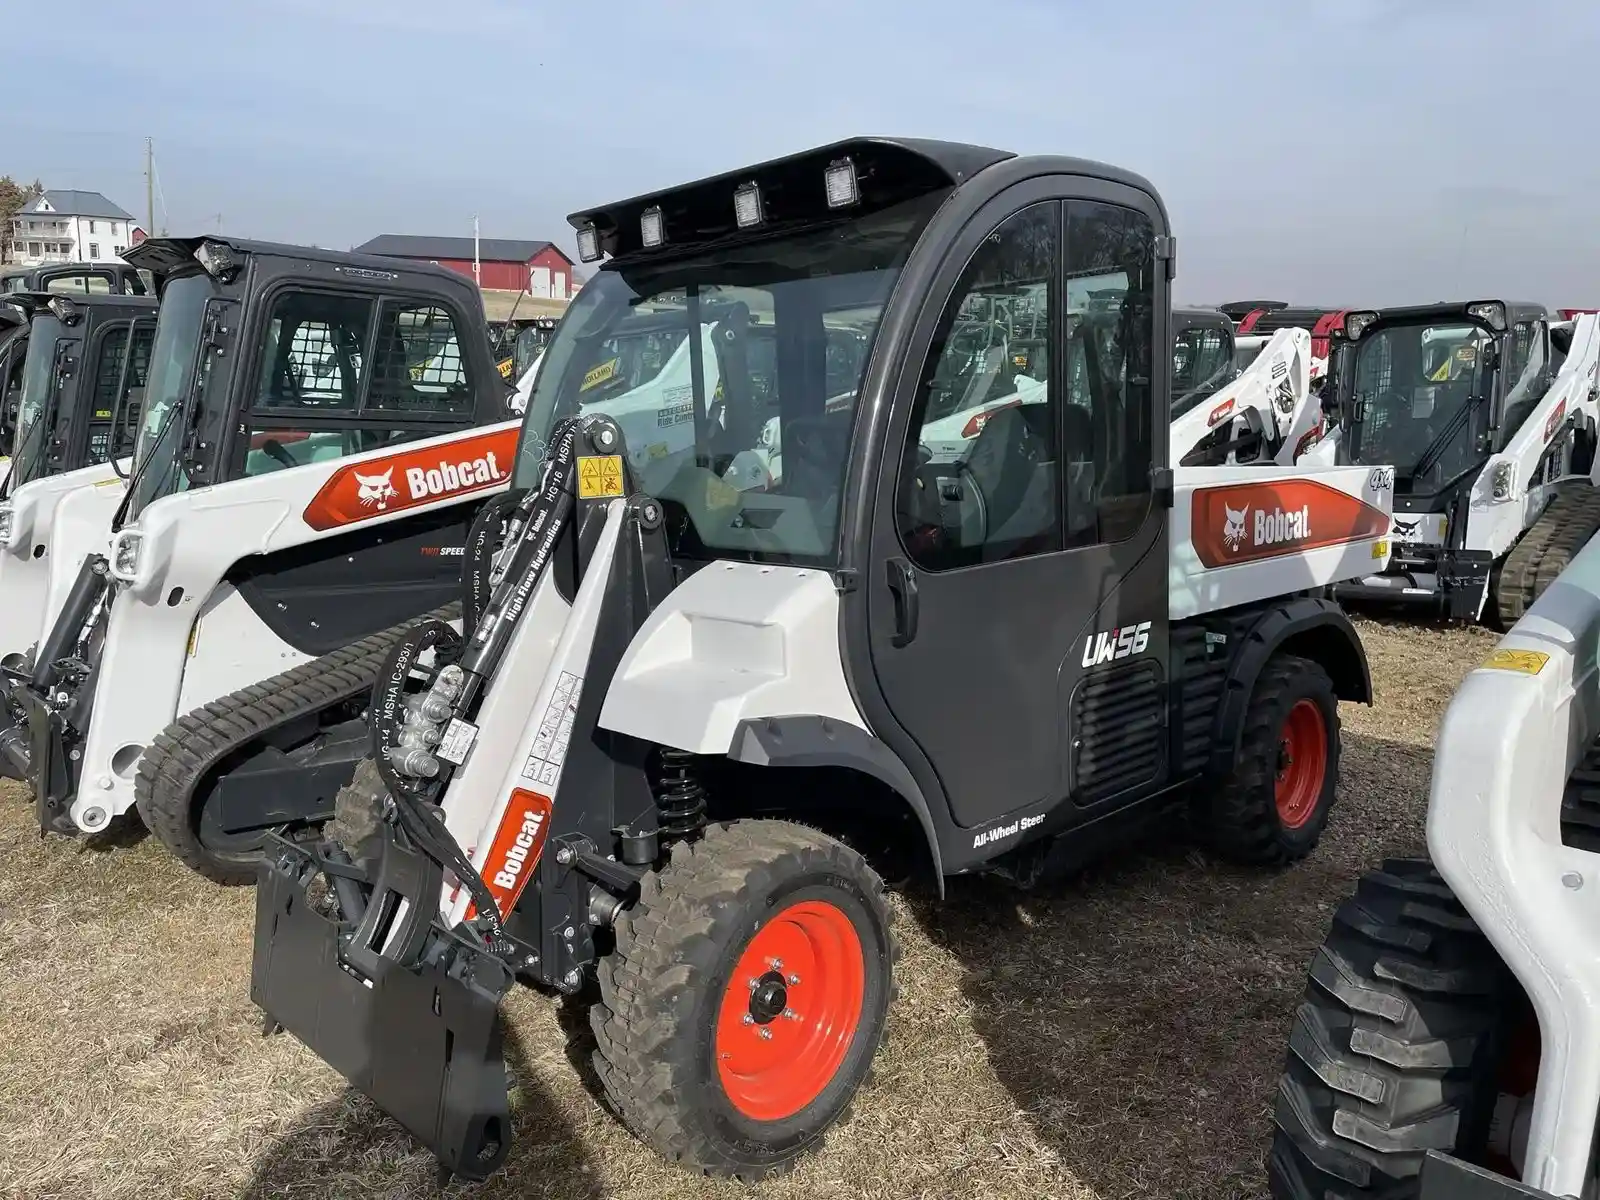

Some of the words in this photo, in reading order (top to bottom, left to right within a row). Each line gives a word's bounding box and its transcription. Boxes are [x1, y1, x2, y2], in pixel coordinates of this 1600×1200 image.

[405, 451, 500, 500] Bobcat
[545, 470, 563, 502] HG-16
[557, 433, 574, 465] MSHA
[1370, 468, 1393, 491] 4x4
[1254, 505, 1309, 546] Bobcat
[505, 597, 525, 622] High
[518, 571, 536, 597] Flow
[530, 519, 562, 571] Hydraulics
[391, 642, 414, 684] IC-293/1
[384, 687, 399, 719] MSHA
[493, 809, 545, 890] Bobcat
[973, 821, 1019, 849] All-Wheel
[1020, 813, 1046, 830] Steer
